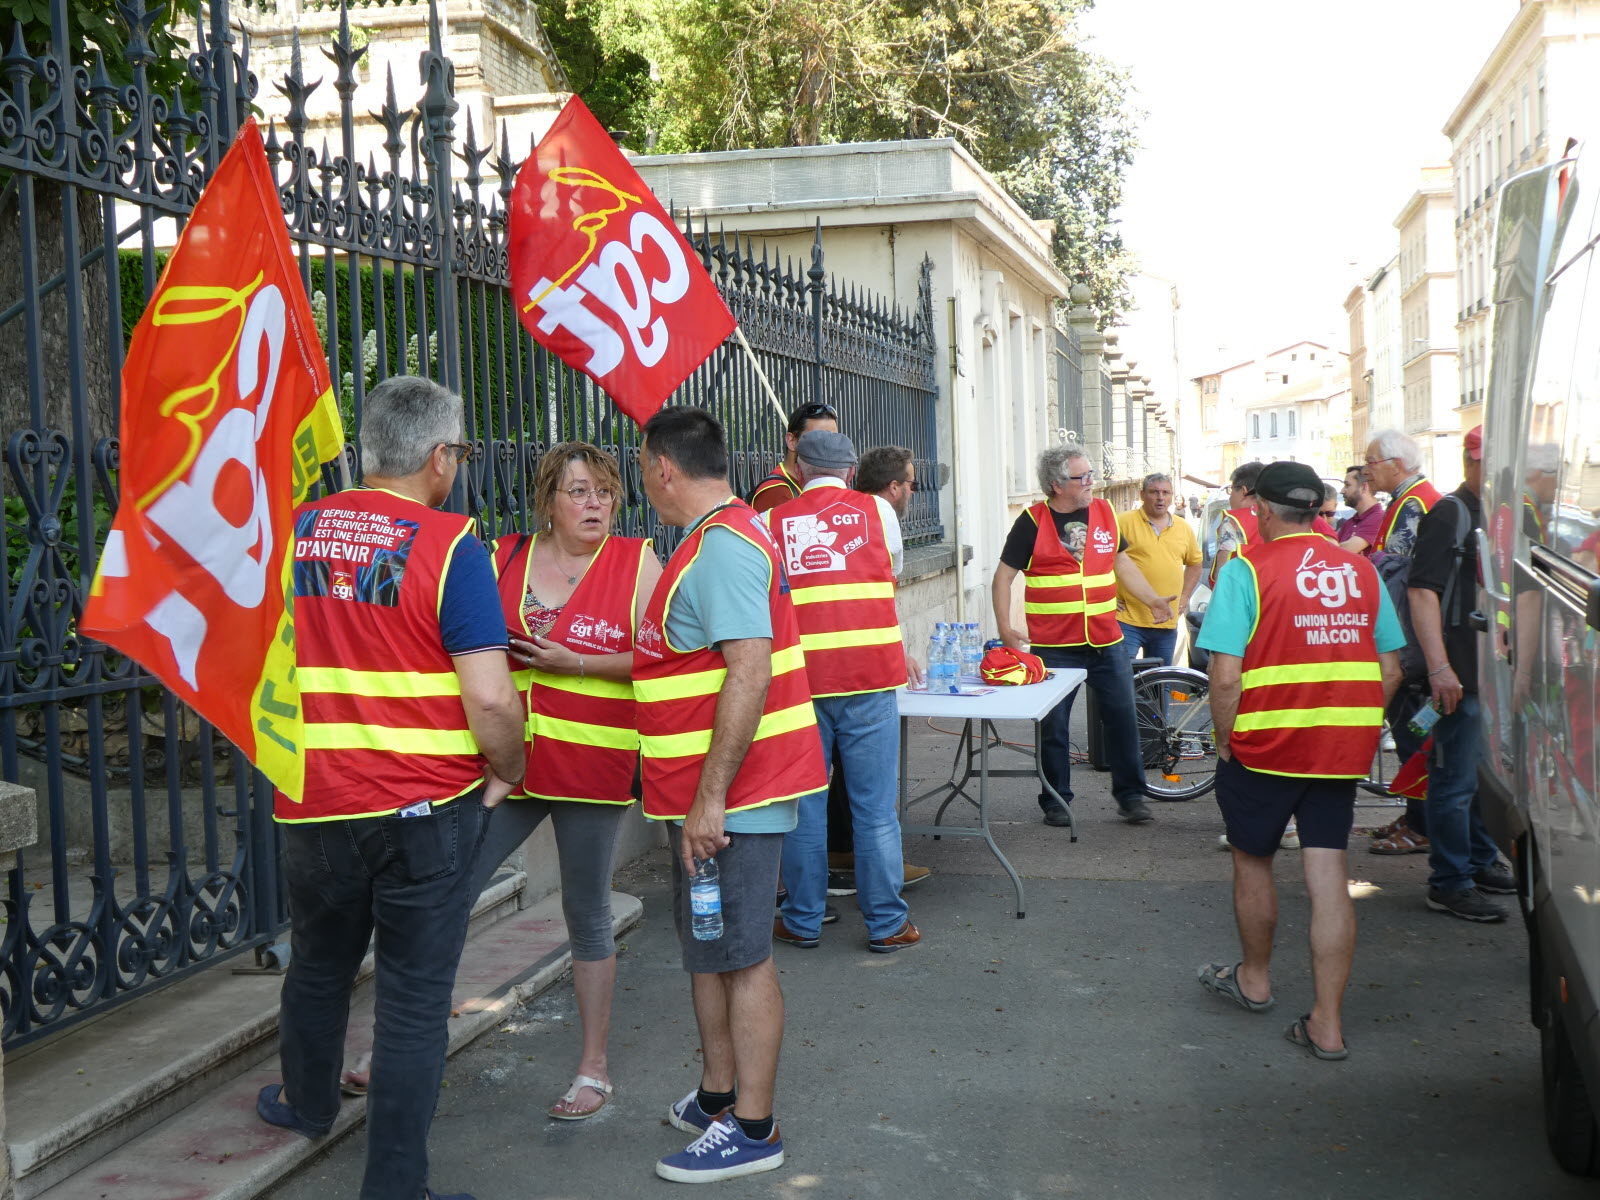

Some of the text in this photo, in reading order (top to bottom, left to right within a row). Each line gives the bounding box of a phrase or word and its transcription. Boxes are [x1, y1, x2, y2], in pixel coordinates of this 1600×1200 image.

[321, 508, 391, 526] DEPUIS 75 ANS,
[832, 513, 860, 526] CGT
[318, 518, 407, 538] LE SERVICE PUBLIC
[314, 528, 395, 547] EST UNE ÉNERGIE
[843, 535, 864, 554] FSM
[295, 540, 370, 563] D'AVENIR
[332, 584, 353, 599] cgt
[1296, 562, 1362, 608] cgt
[1294, 613, 1369, 628] UNION LOCALE
[569, 624, 593, 638] cgt
[1306, 628, 1360, 645] MÂCON
[720, 1145, 739, 1158] FILA
